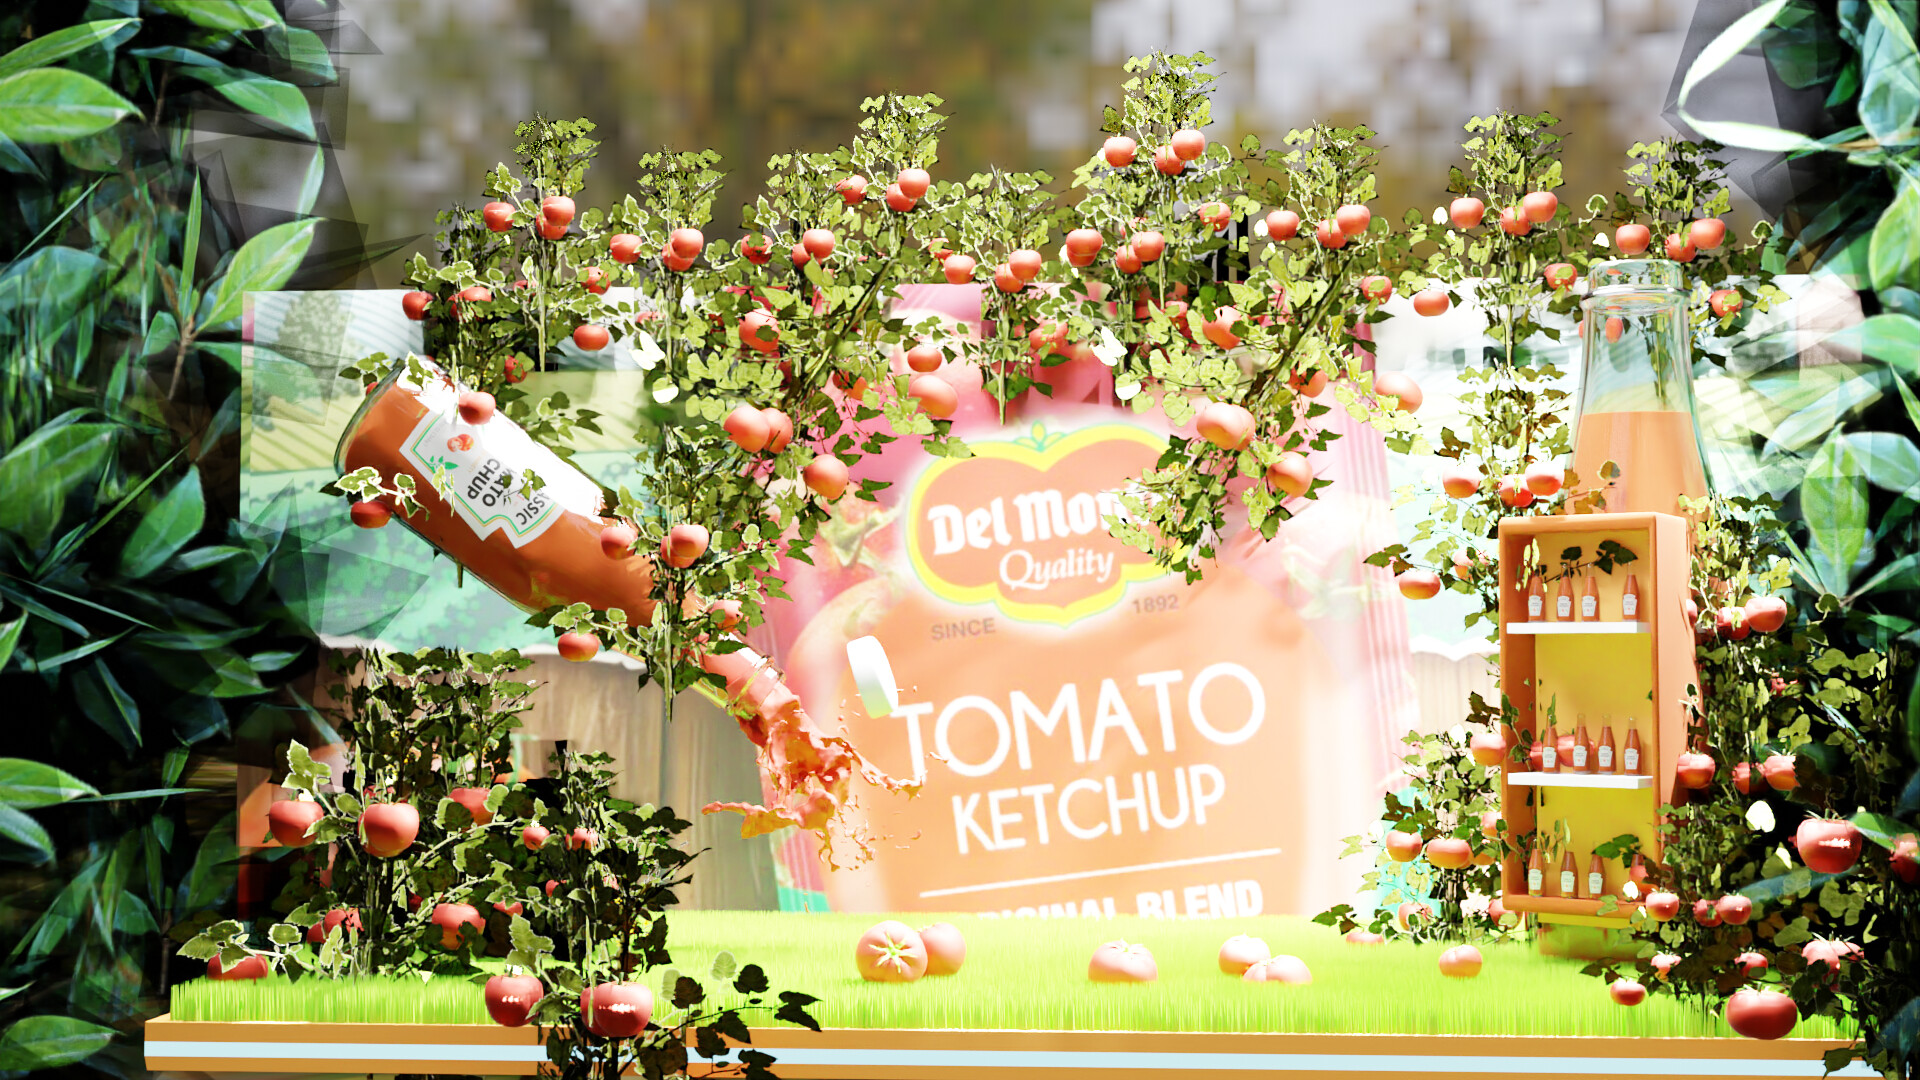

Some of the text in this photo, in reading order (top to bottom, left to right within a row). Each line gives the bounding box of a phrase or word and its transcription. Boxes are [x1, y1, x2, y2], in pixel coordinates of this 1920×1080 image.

[467, 458, 501, 500] CHUP
[927, 496, 1011, 556] Del
[999, 548, 1114, 591] Quality
[930, 594, 1179, 642] SINCE 1892
[890, 662, 1266, 781] TOMATO
[951, 764, 1226, 855] KETCHUP
